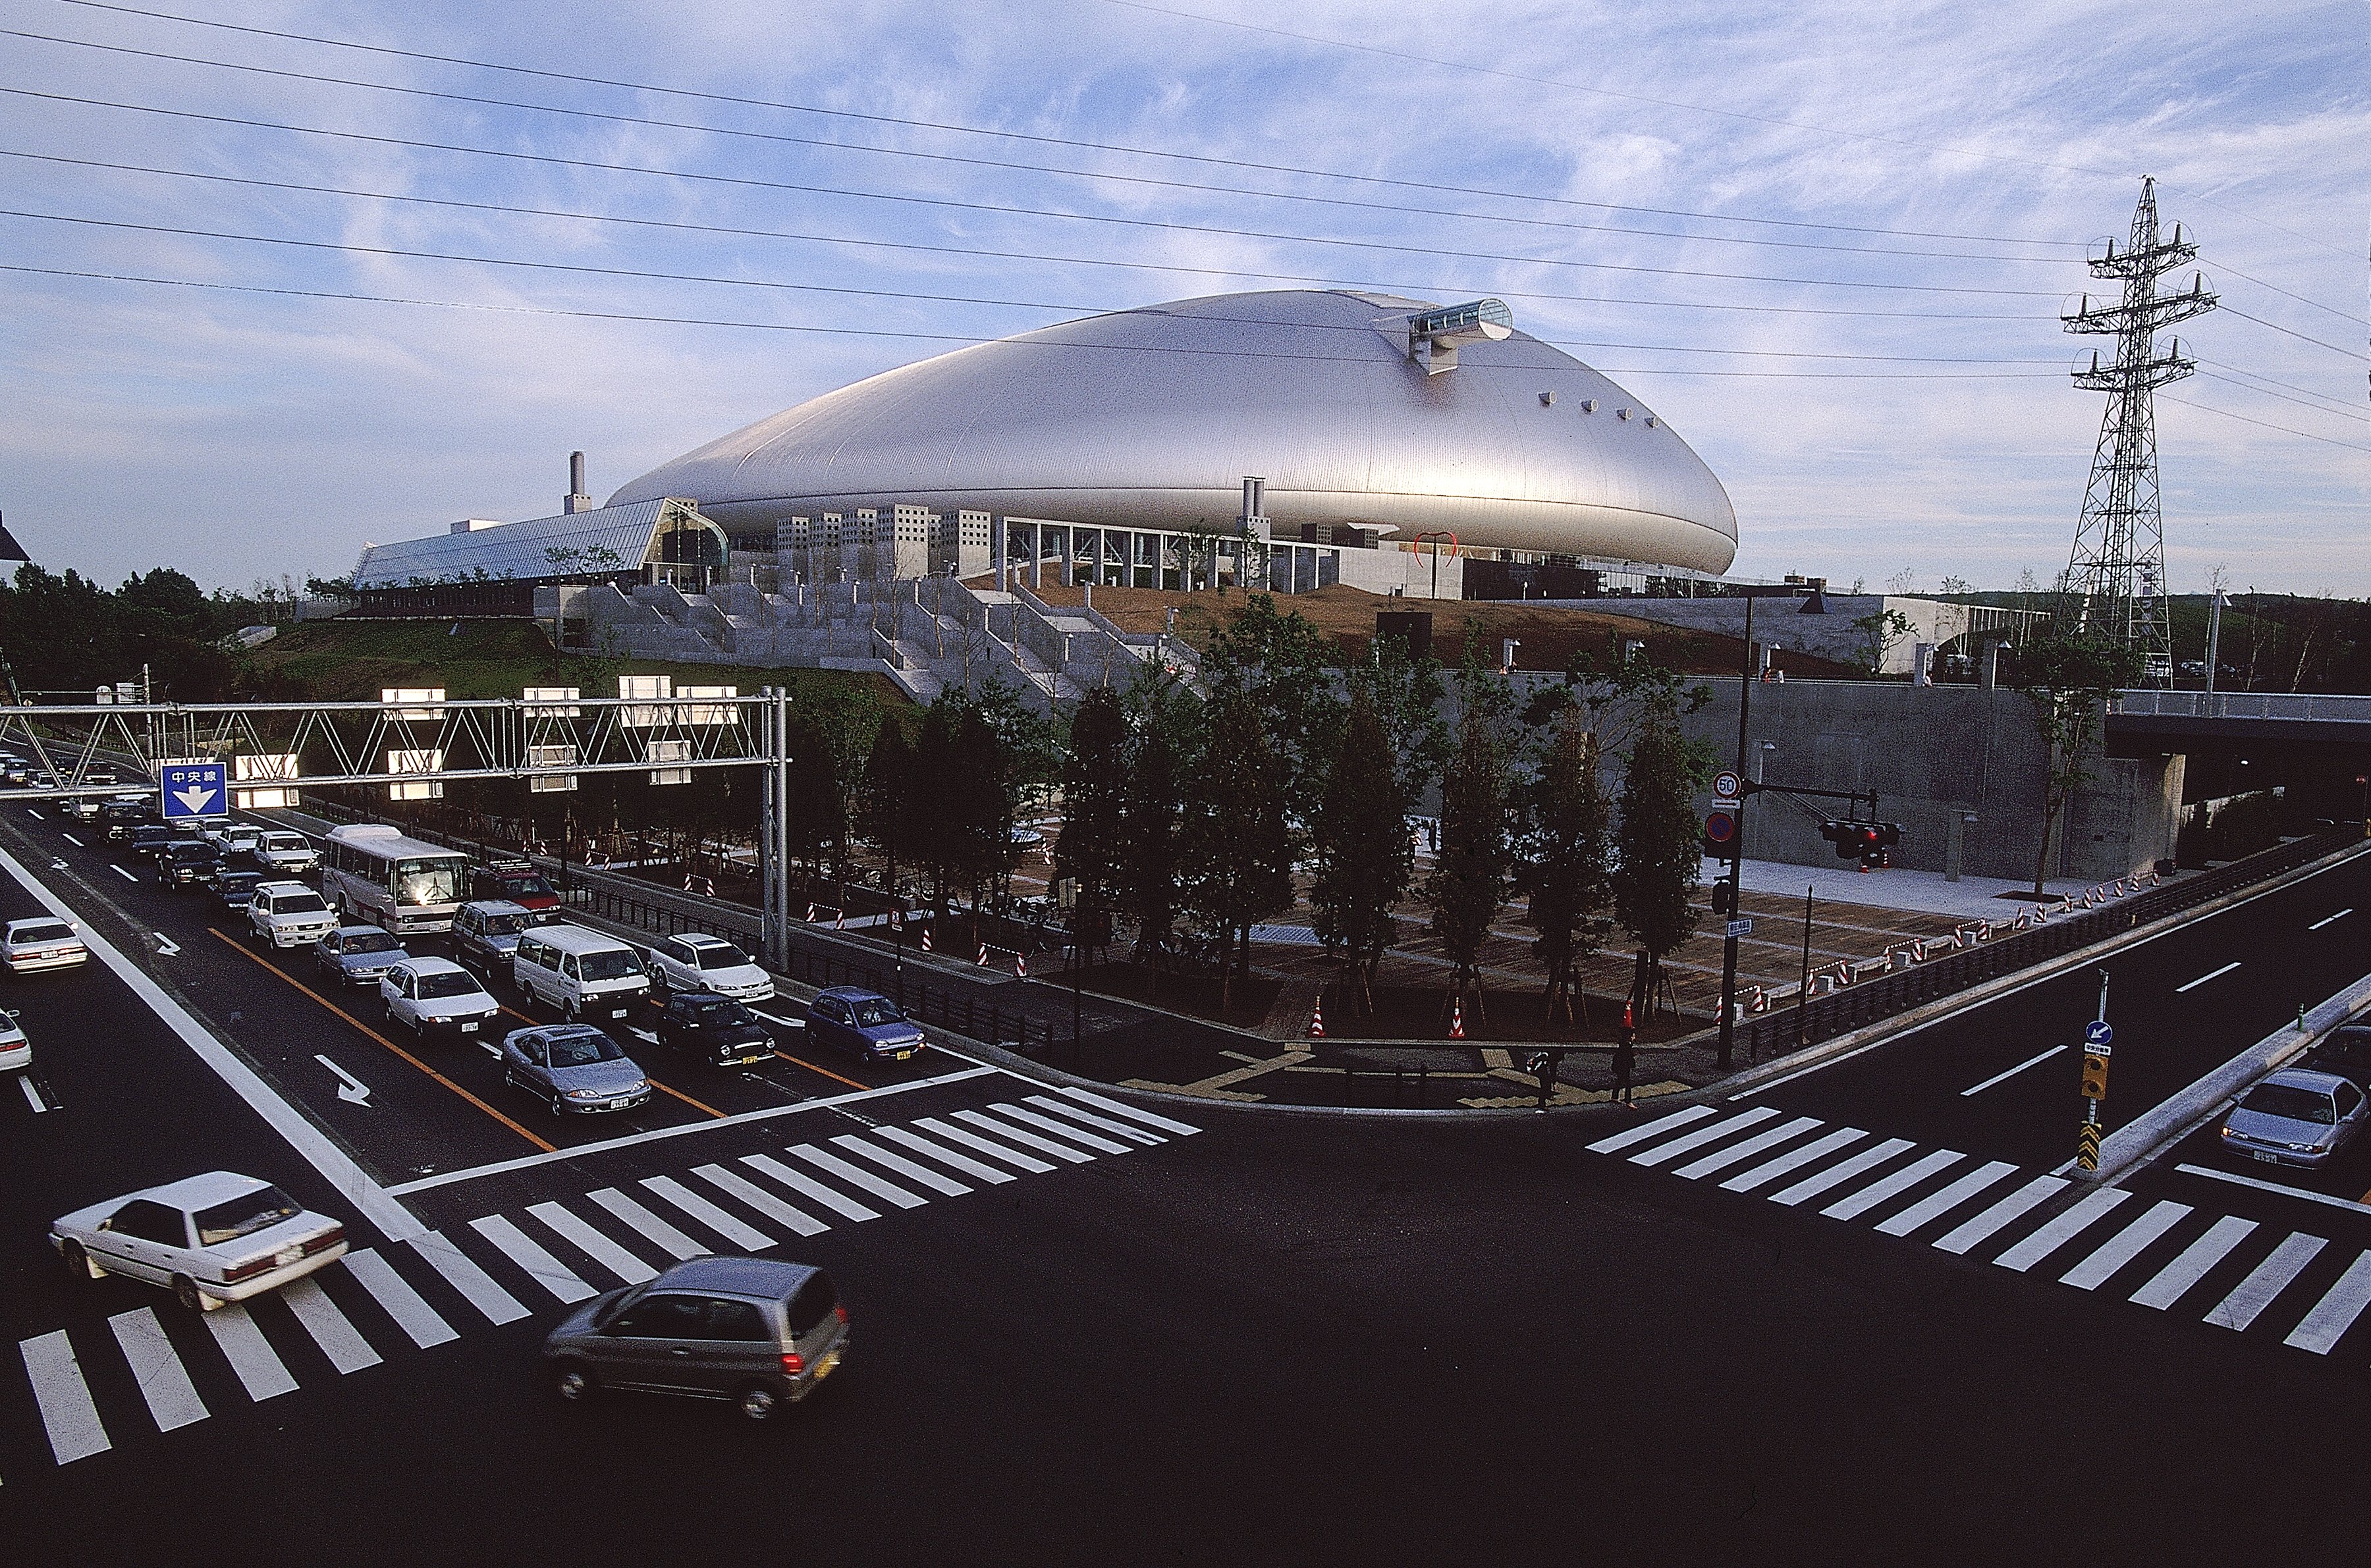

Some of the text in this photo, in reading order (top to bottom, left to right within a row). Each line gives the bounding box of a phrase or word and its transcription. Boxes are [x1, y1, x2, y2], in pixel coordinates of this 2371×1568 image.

[172, 770, 217, 784] 中央線
[1719, 778, 1735, 792] 50
